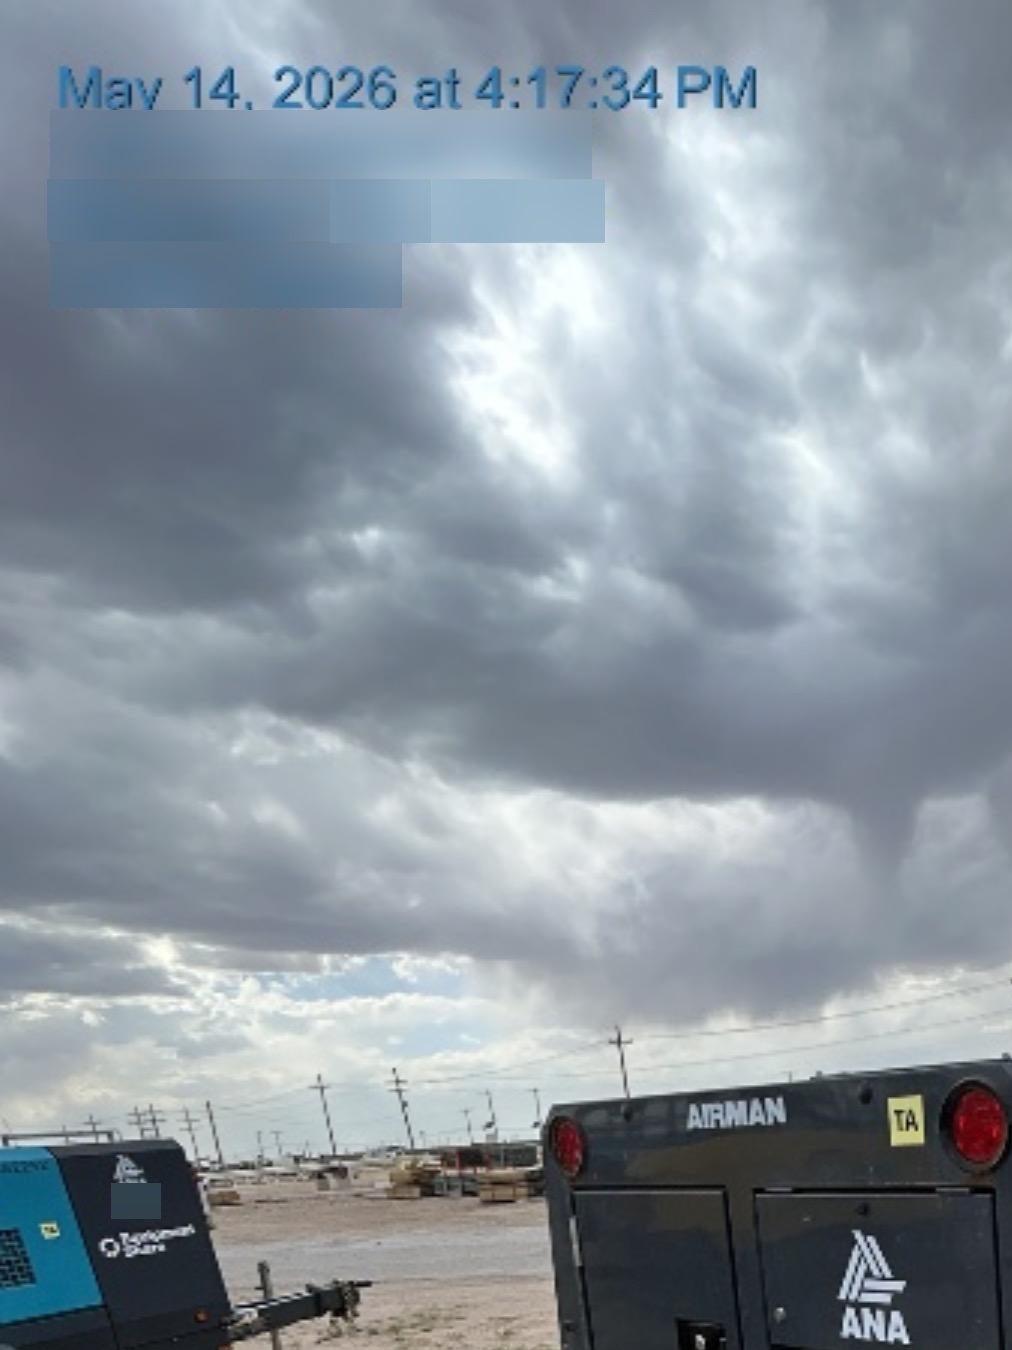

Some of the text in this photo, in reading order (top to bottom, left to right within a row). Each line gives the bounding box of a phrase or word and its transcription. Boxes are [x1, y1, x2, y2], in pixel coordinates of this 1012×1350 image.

[686, 1096, 788, 1130] AIRMAN
[893, 1109, 918, 1132] TA
[840, 1306, 910, 1345] ANA
